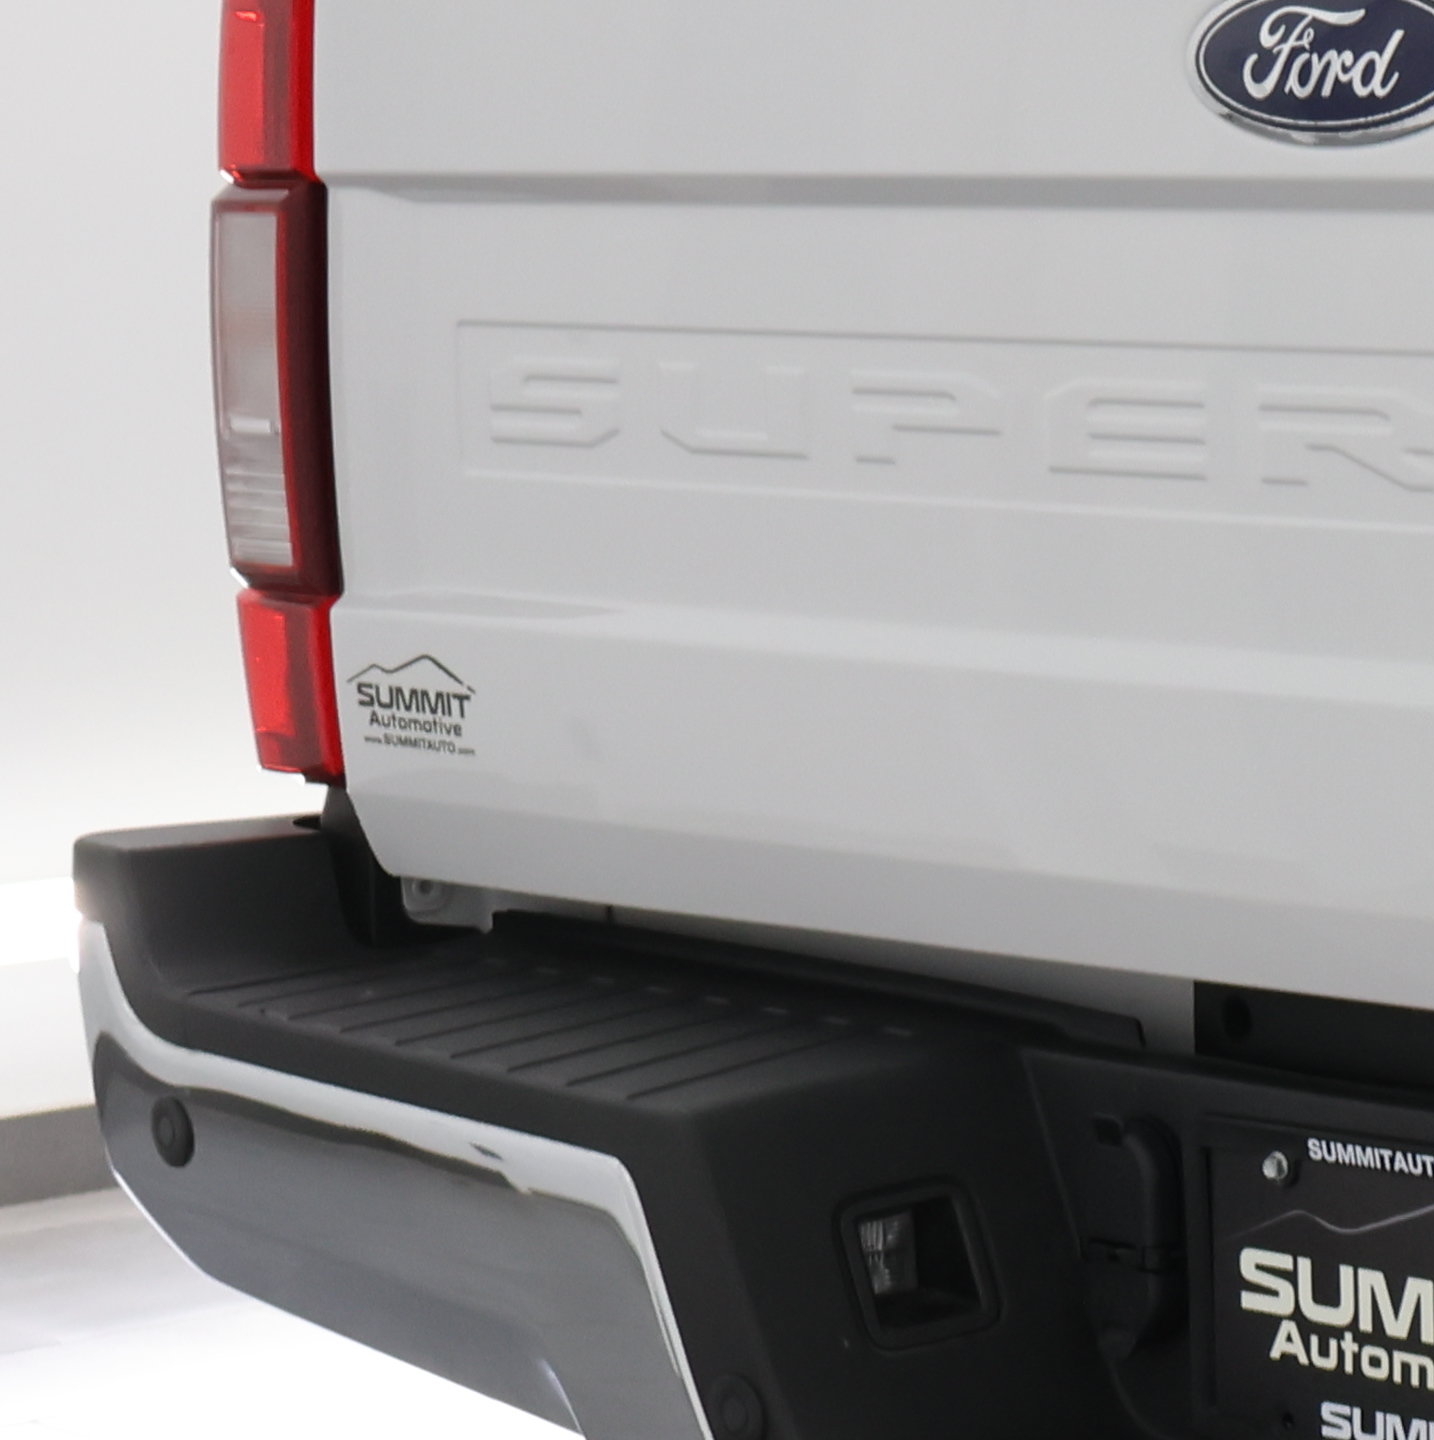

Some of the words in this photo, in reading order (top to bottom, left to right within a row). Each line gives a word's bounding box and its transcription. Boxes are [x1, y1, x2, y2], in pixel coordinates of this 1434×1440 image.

[1242, 5, 1405, 100] Ford
[357, 682, 470, 719] SUMMIT
[370, 711, 463, 737] Automotive
